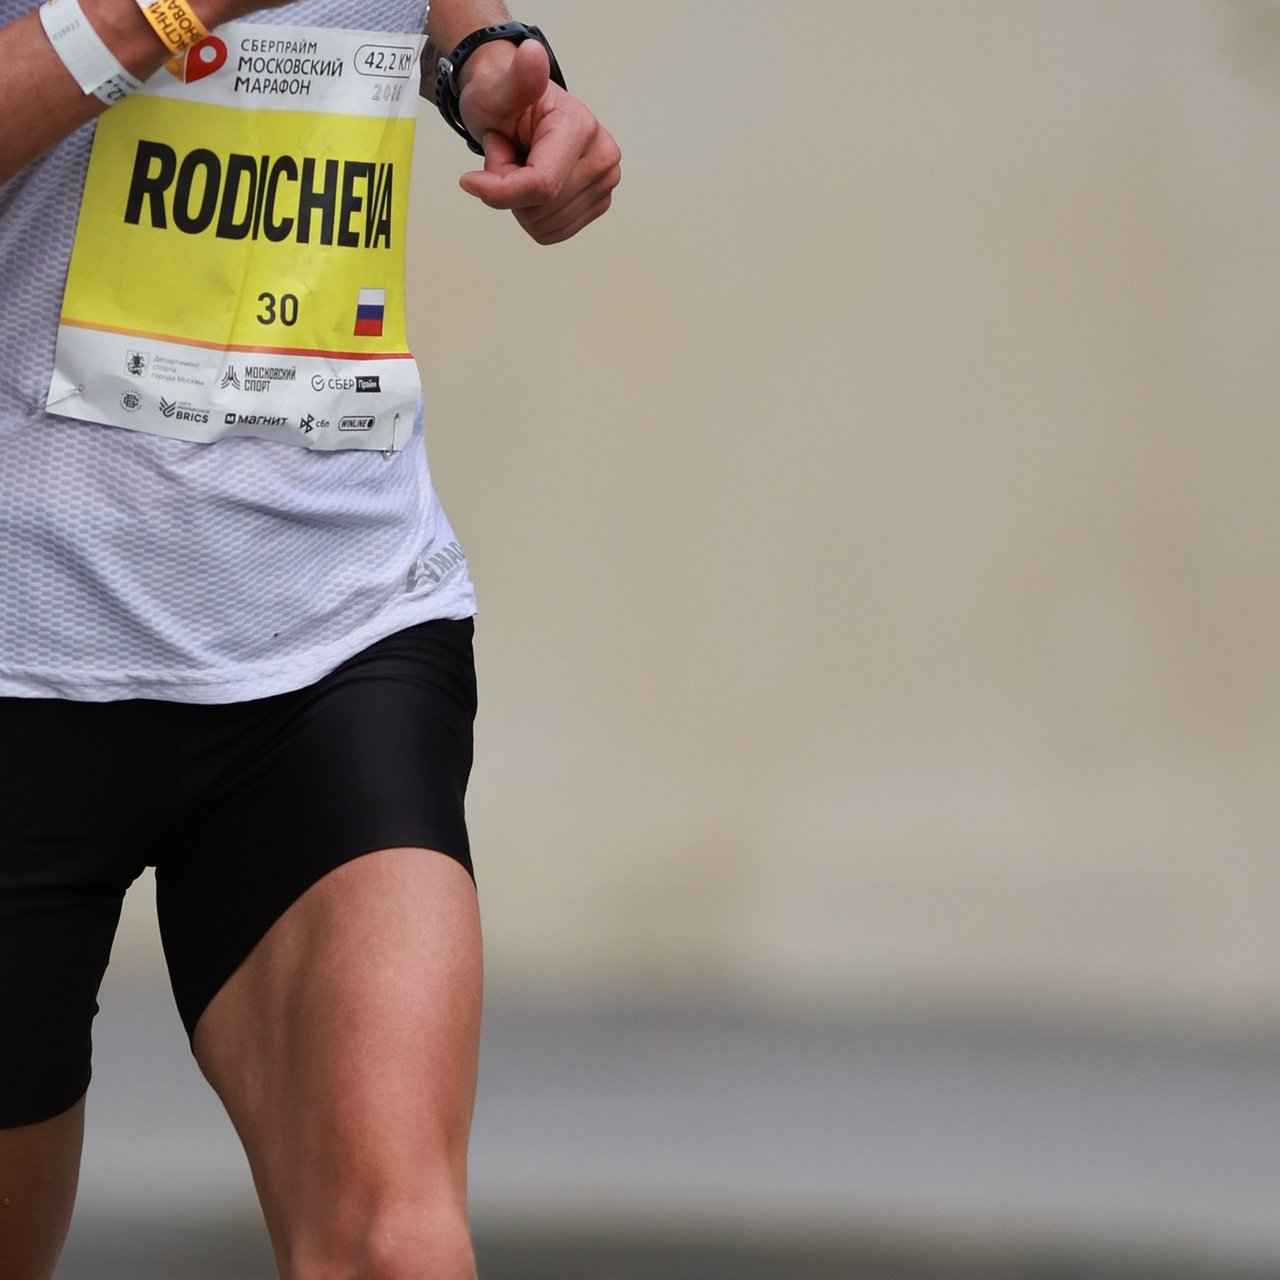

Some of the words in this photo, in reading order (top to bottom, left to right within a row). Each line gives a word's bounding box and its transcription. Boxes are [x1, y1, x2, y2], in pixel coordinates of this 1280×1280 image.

[241, 38, 318, 54] СБЕРПРАЙМ
[238, 56, 344, 77] МОСКОВСКИЙ
[364, 51, 397, 72] 42,2
[234, 76, 311, 96] МАРАФОН
[123, 139, 394, 250] RODICHEVA
[256, 292, 299, 327] 30
[244, 366, 296, 382] МОСКОВСКИЙ
[244, 379, 271, 392] СПОРТ
[176, 410, 209, 424] BRICS
[340, 419, 368, 428] WINLINE
